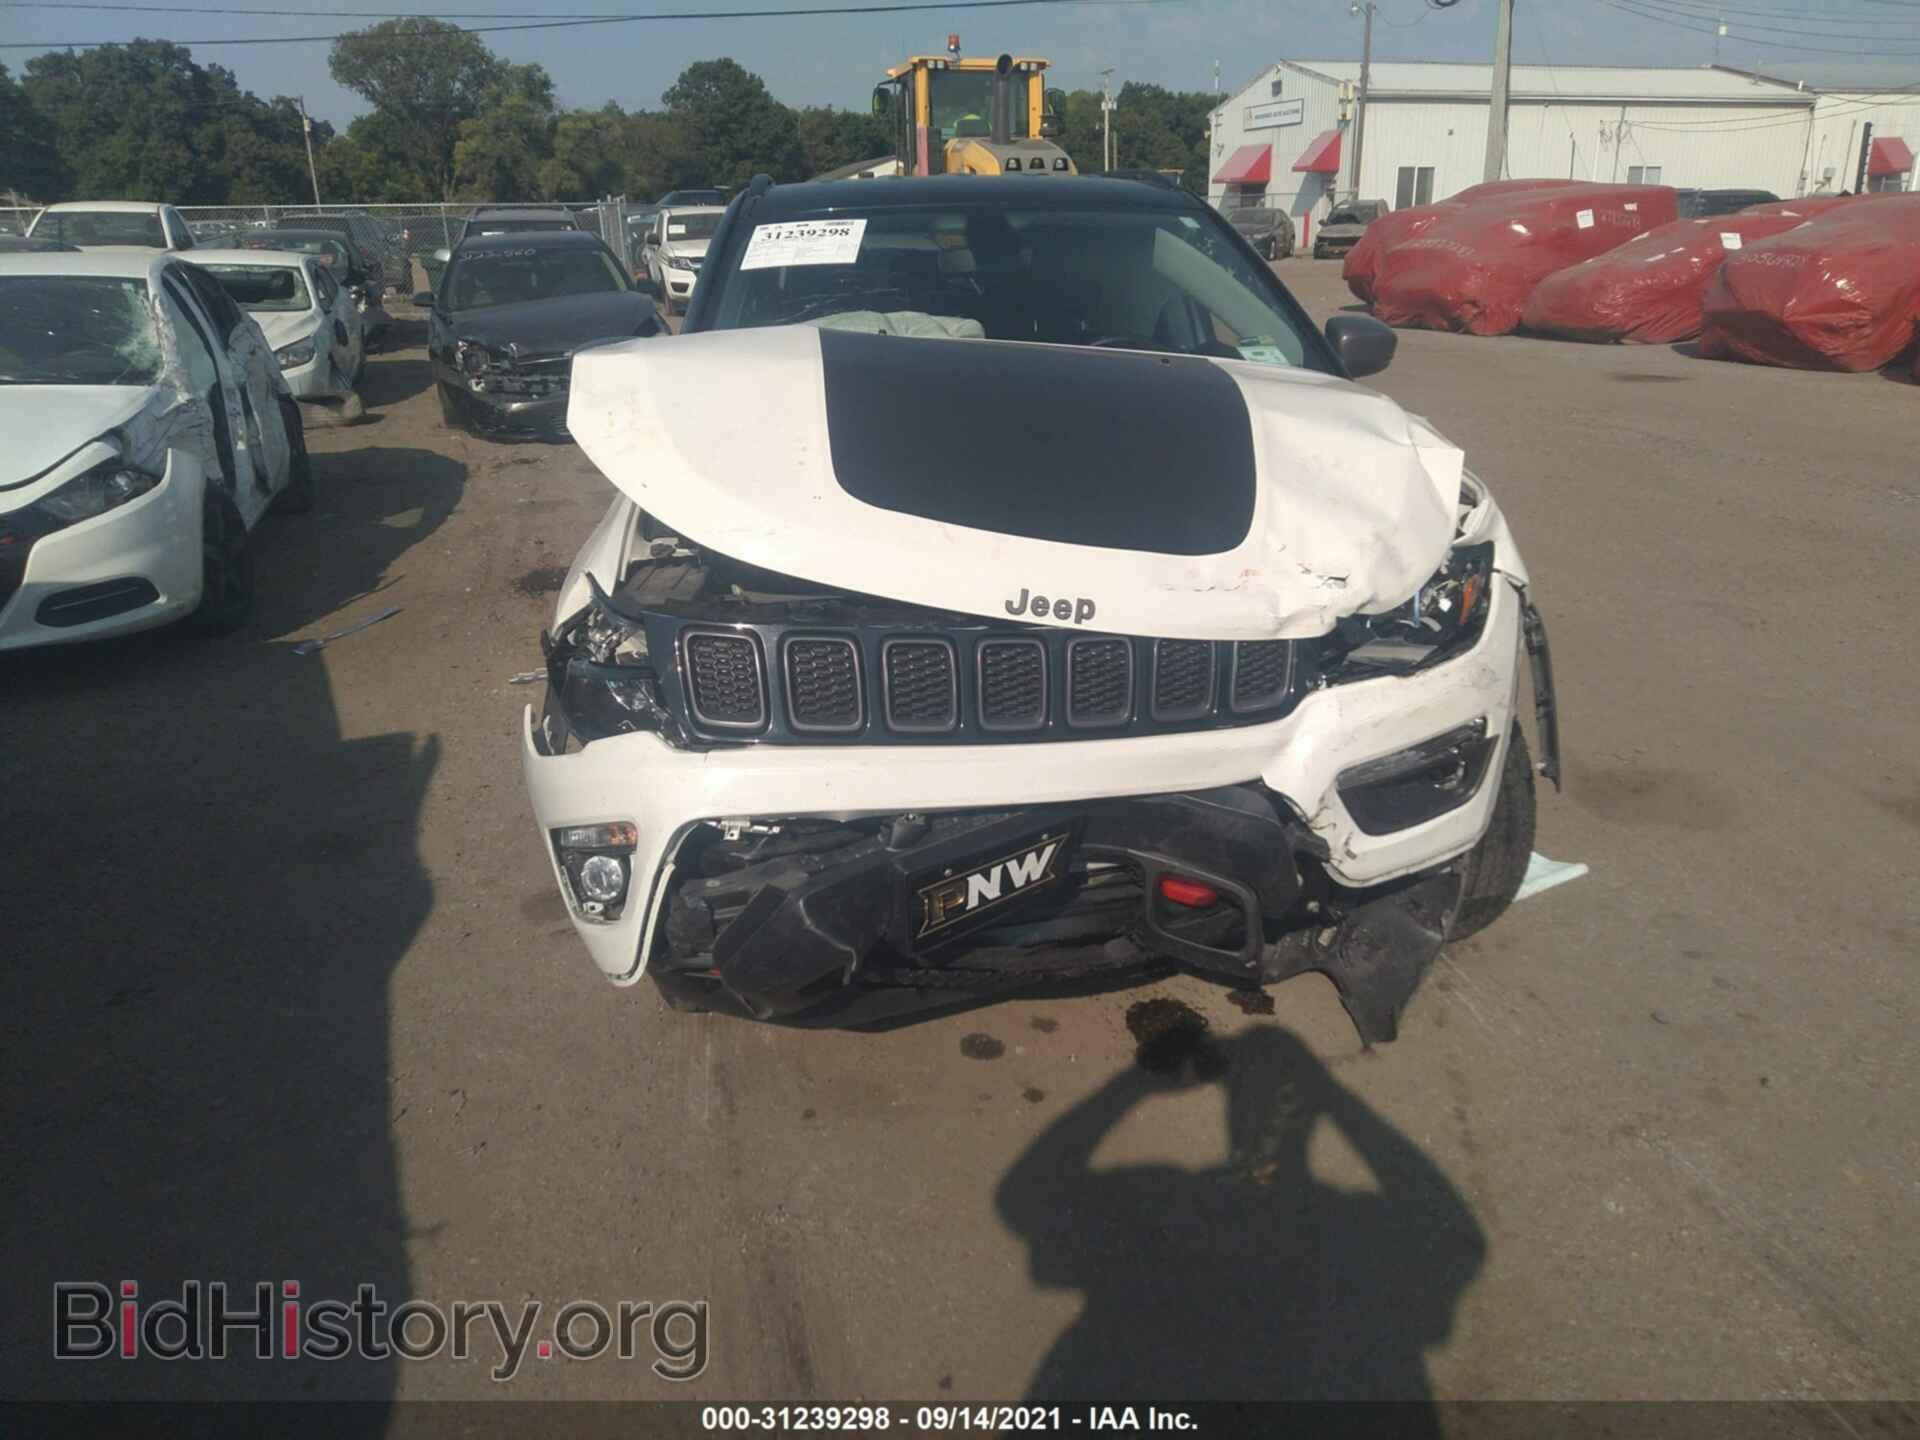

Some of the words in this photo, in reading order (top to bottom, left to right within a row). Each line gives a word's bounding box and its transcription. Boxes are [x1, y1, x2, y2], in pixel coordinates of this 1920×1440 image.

[761, 227, 850, 241] 31239298
[1005, 588, 1096, 624] Jeep
[927, 843, 1057, 926] PNW
